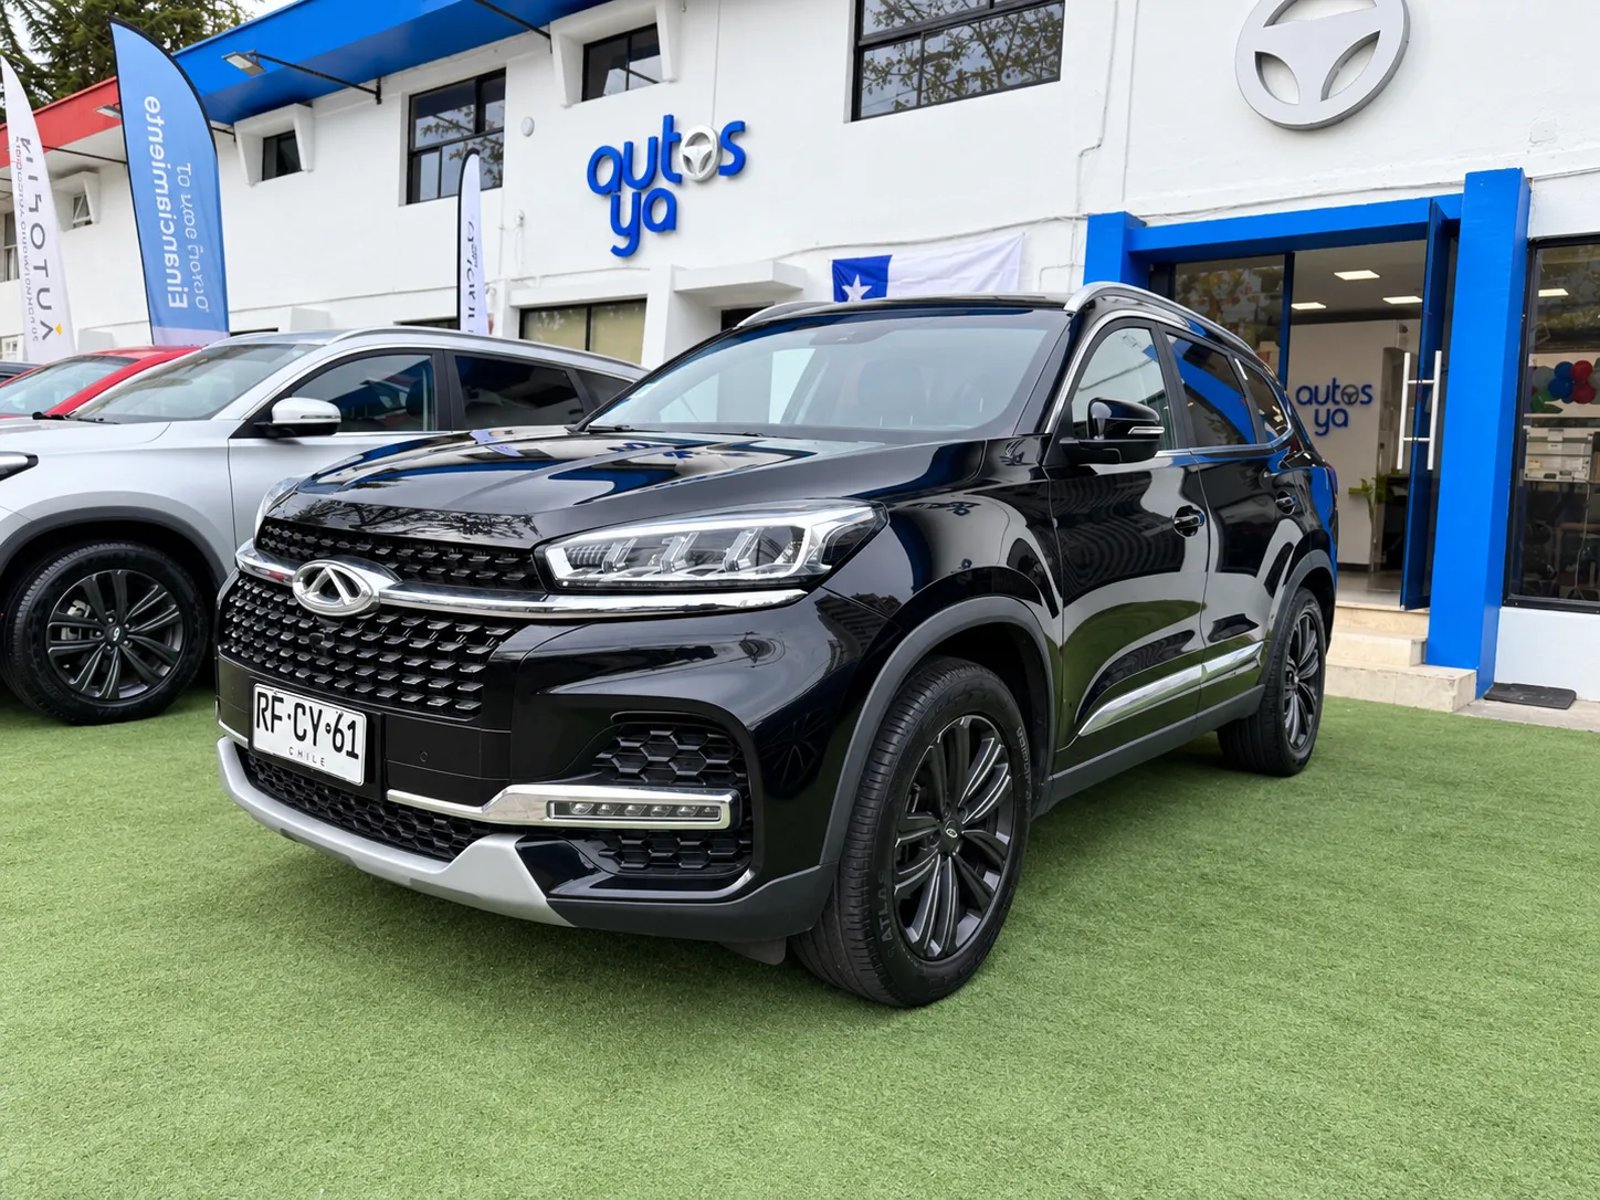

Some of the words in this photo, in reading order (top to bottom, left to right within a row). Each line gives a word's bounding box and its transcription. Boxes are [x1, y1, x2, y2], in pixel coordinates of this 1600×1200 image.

[587, 114, 747, 195] autos
[610, 187, 678, 258] ya
[1296, 377, 1374, 406] autos
[1314, 408, 1349, 437] ya
[288, 746, 326, 767] CHILE
